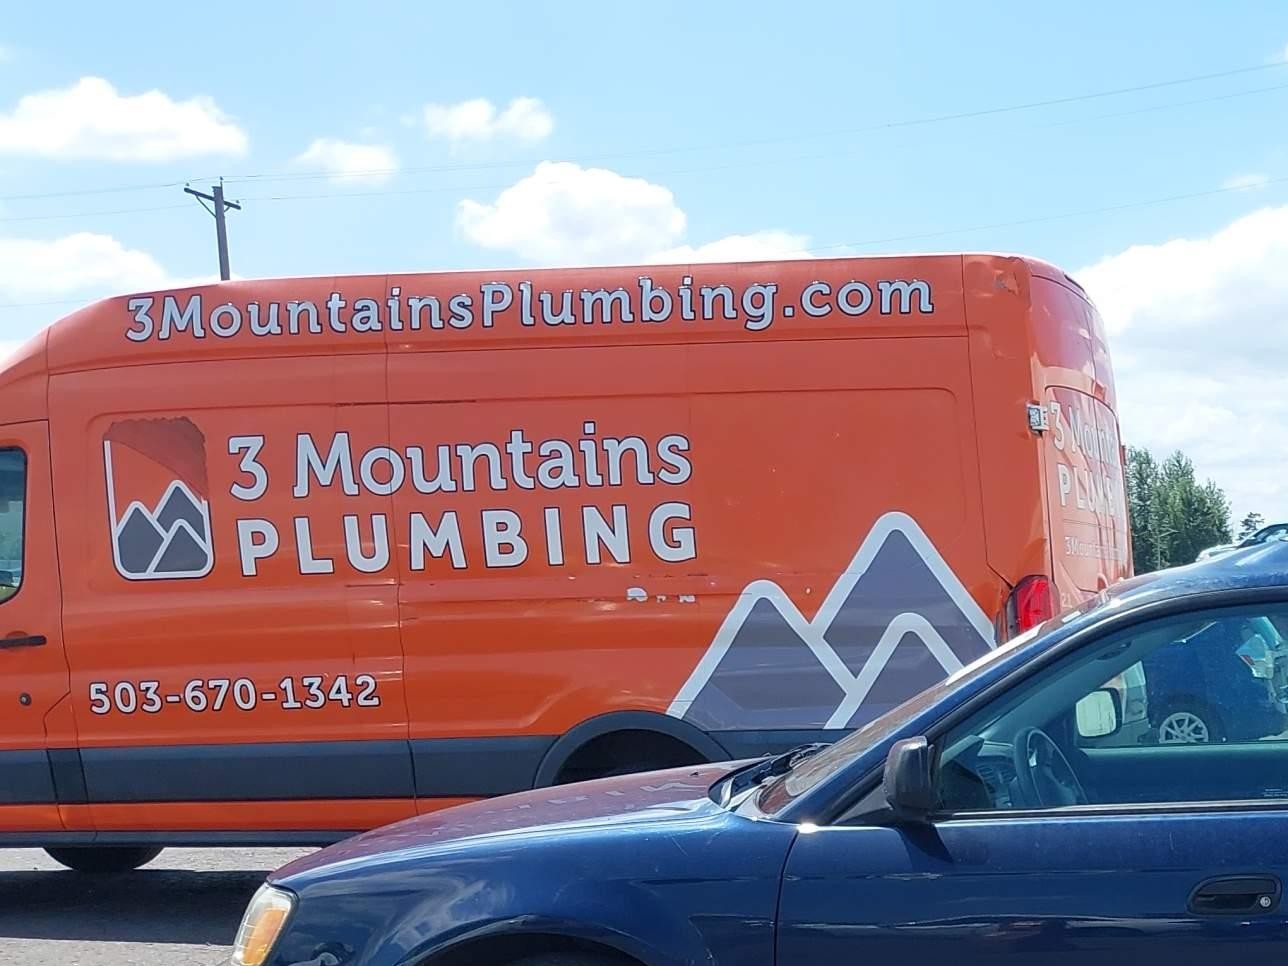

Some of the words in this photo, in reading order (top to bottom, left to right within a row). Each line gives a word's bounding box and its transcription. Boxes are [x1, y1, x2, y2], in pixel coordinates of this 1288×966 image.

[126, 275, 935, 342] 3MountainsPlumbing.com
[227, 434, 269, 502] 3
[292, 421, 693, 499] Mountains
[235, 501, 697, 577] PLUMBING
[88, 674, 381, 714] 503-670-1342
